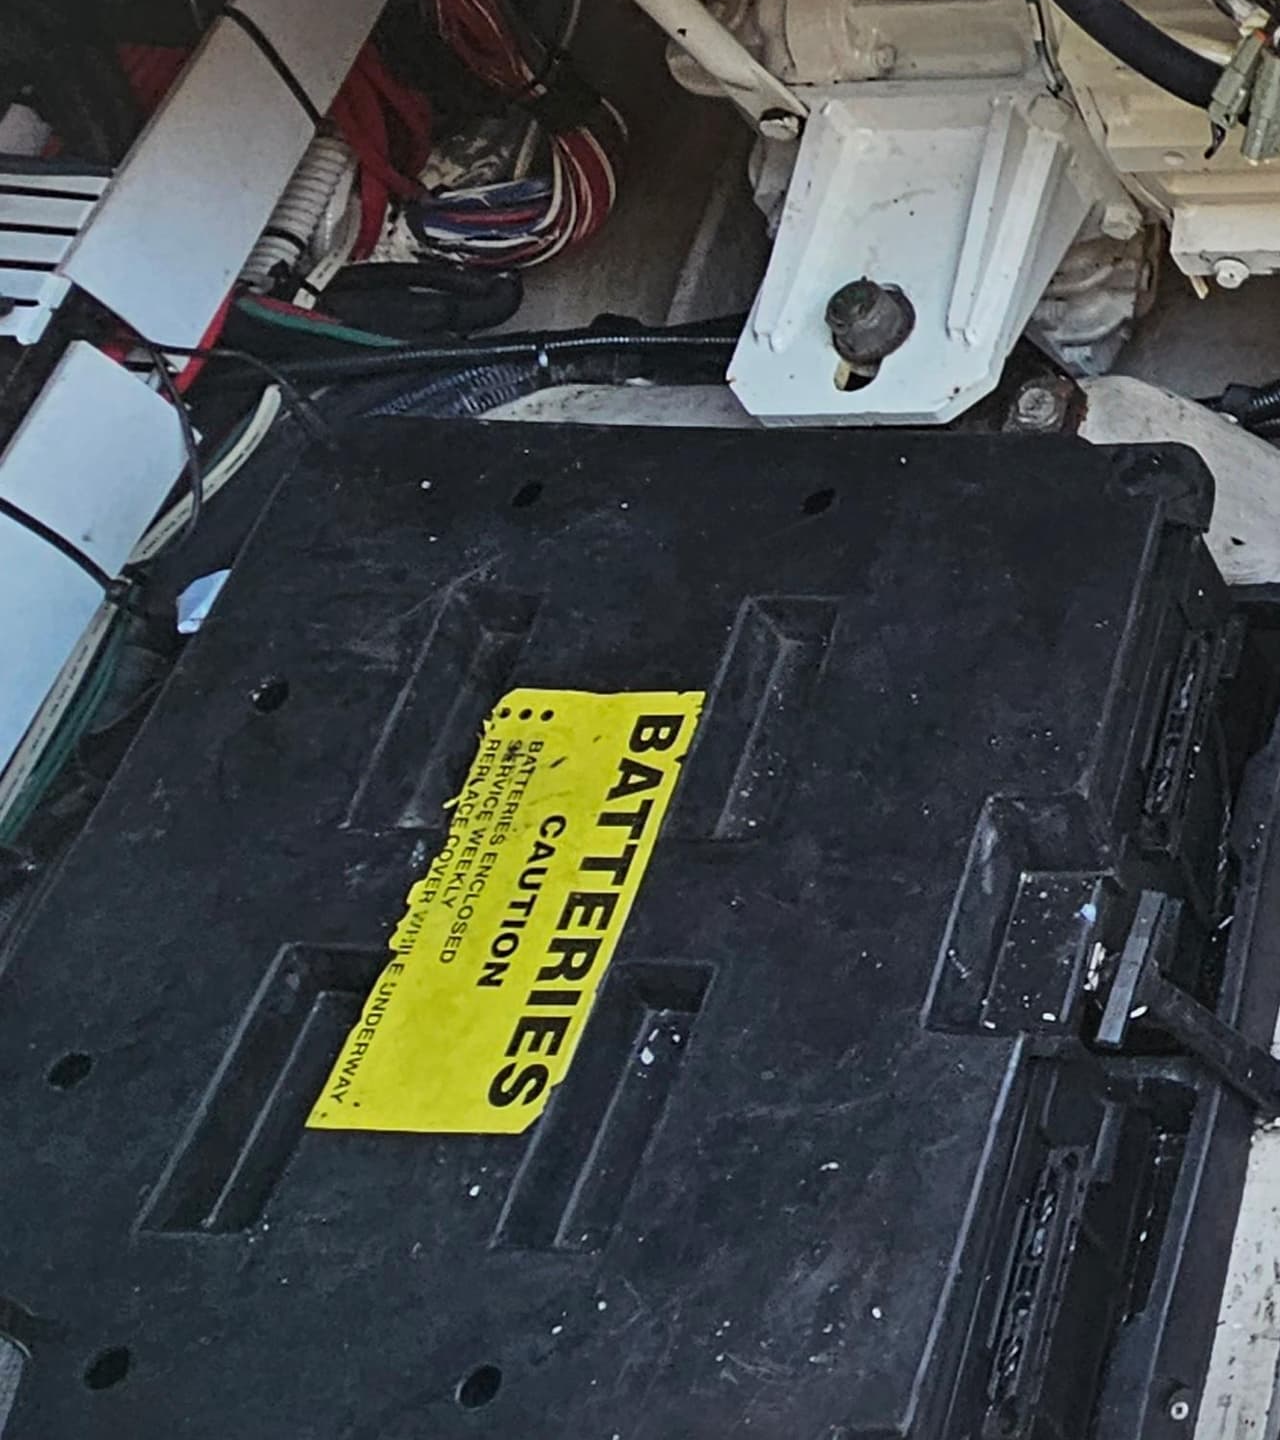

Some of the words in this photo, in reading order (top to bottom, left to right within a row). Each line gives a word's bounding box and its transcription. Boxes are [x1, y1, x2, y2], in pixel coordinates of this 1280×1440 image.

[480, 739, 523, 822] SERVICE
[489, 740, 544, 846] BATTERIES
[418, 833, 460, 904] COVER
[439, 852, 498, 964] ENCLOSED
[441, 827, 484, 909] WEEKLY
[476, 814, 567, 987] CAUTION
[488, 714, 685, 1108] BATTERIES
[330, 981, 397, 1104] UNDERWAY
